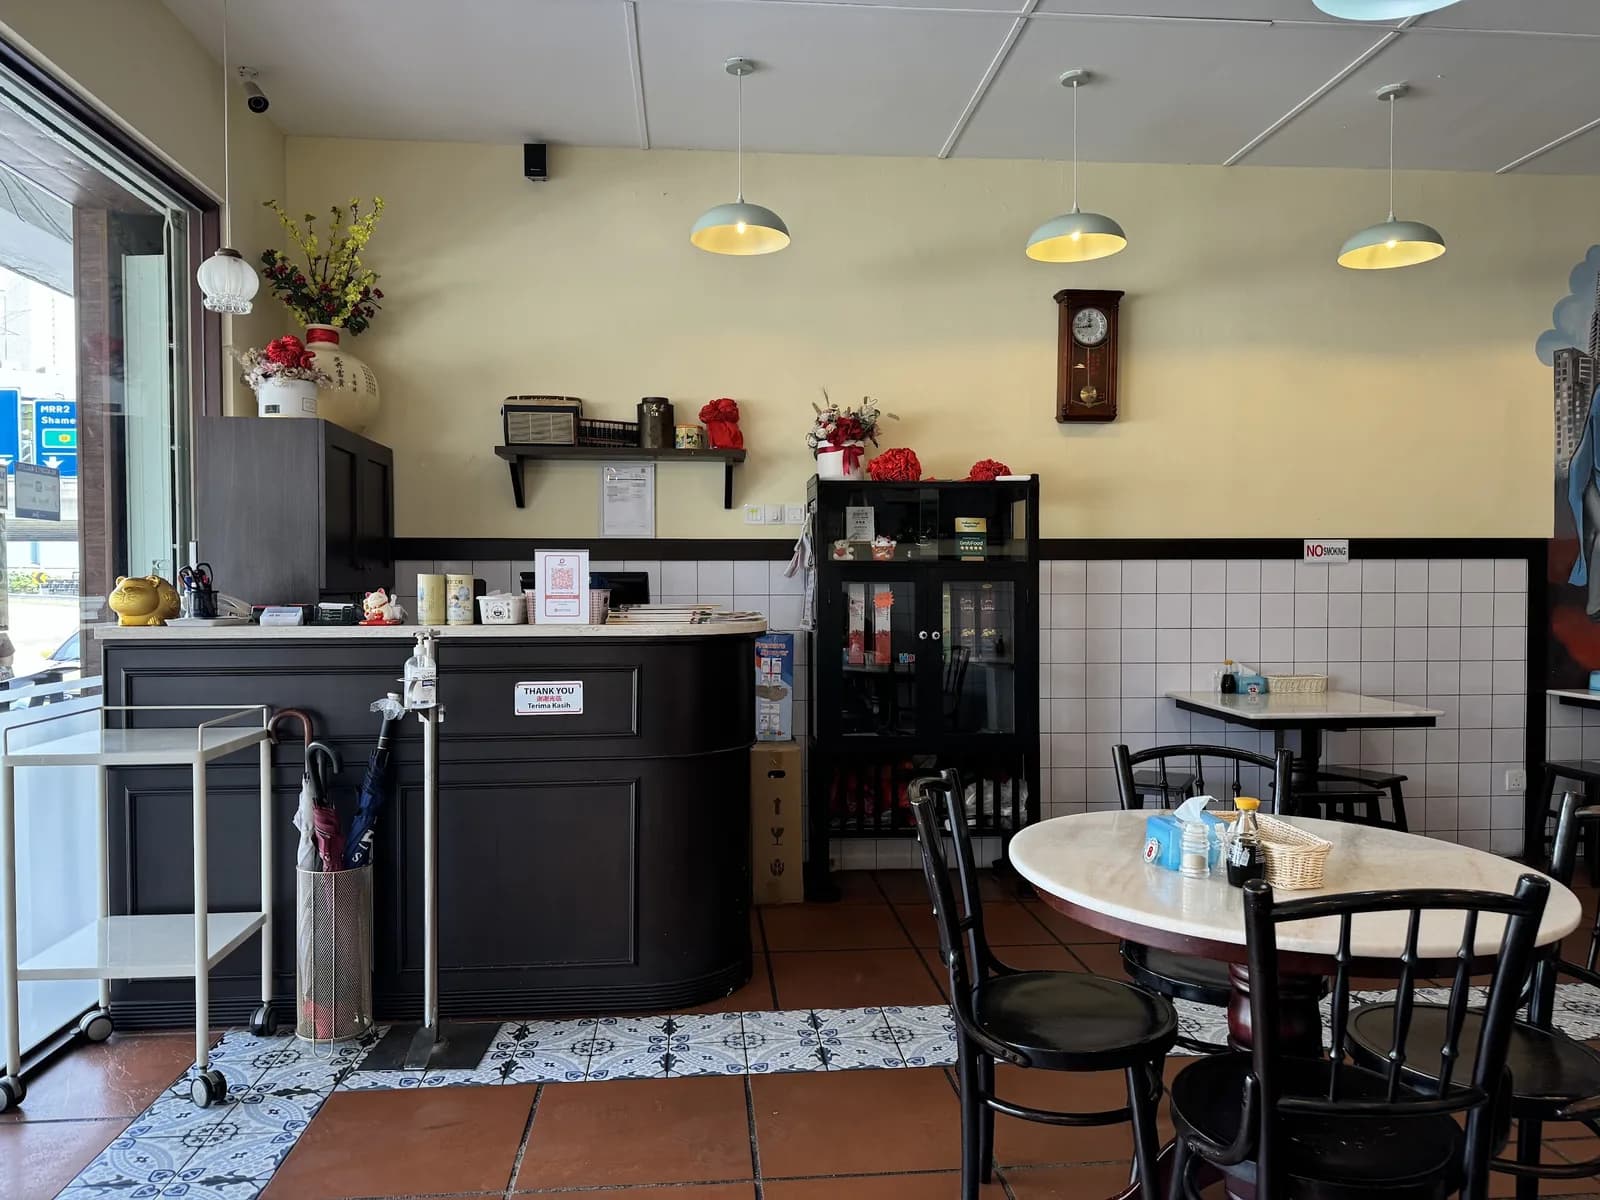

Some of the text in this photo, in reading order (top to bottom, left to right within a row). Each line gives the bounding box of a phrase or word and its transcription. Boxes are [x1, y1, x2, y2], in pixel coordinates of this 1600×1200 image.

[40, 405, 71, 414] MRR2
[1306, 544, 1346, 557] NO SMOKING
[1146, 846, 1154, 858] 8
